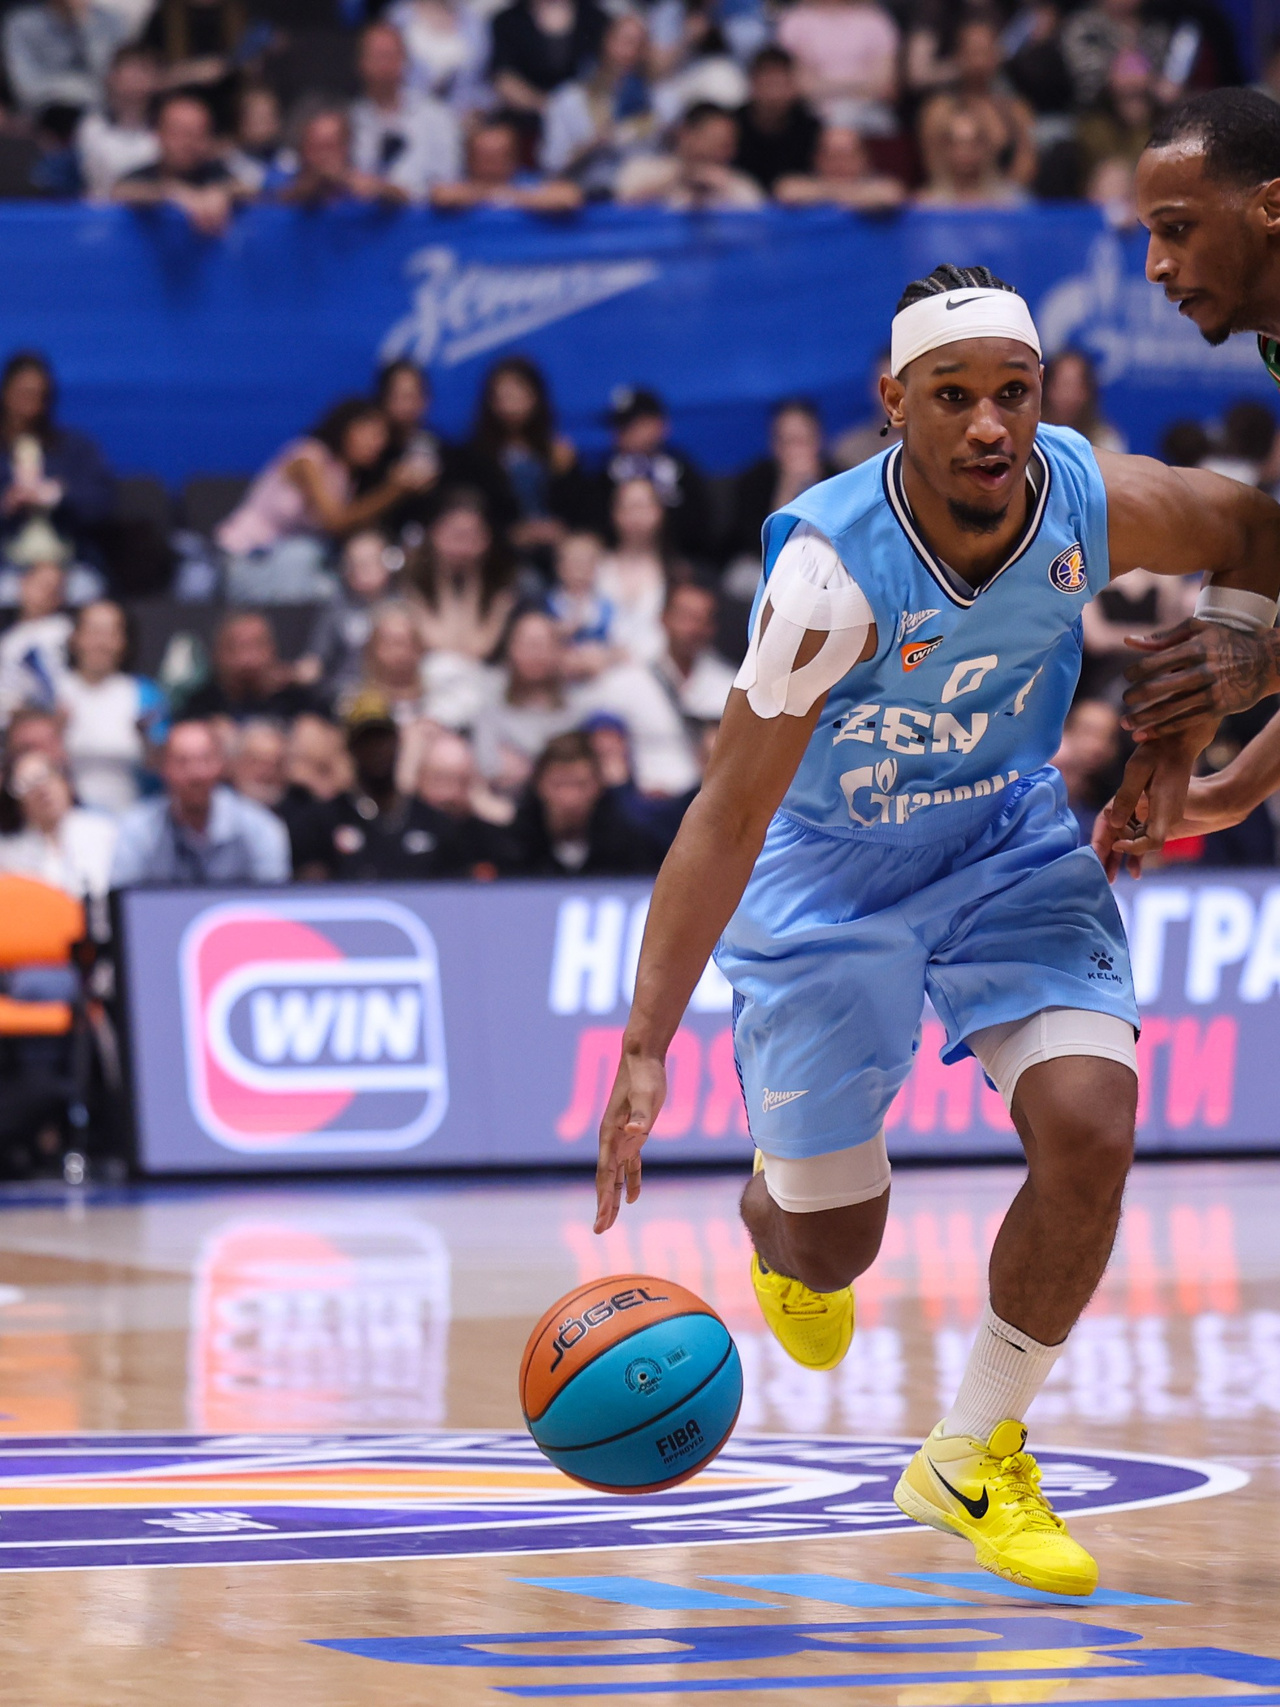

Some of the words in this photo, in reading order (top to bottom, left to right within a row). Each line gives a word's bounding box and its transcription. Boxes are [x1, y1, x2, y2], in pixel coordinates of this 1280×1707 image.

[249, 989, 422, 1064] WIN
[551, 1287, 669, 1373] JÖGEL
[656, 1419, 701, 1457] FIBA
